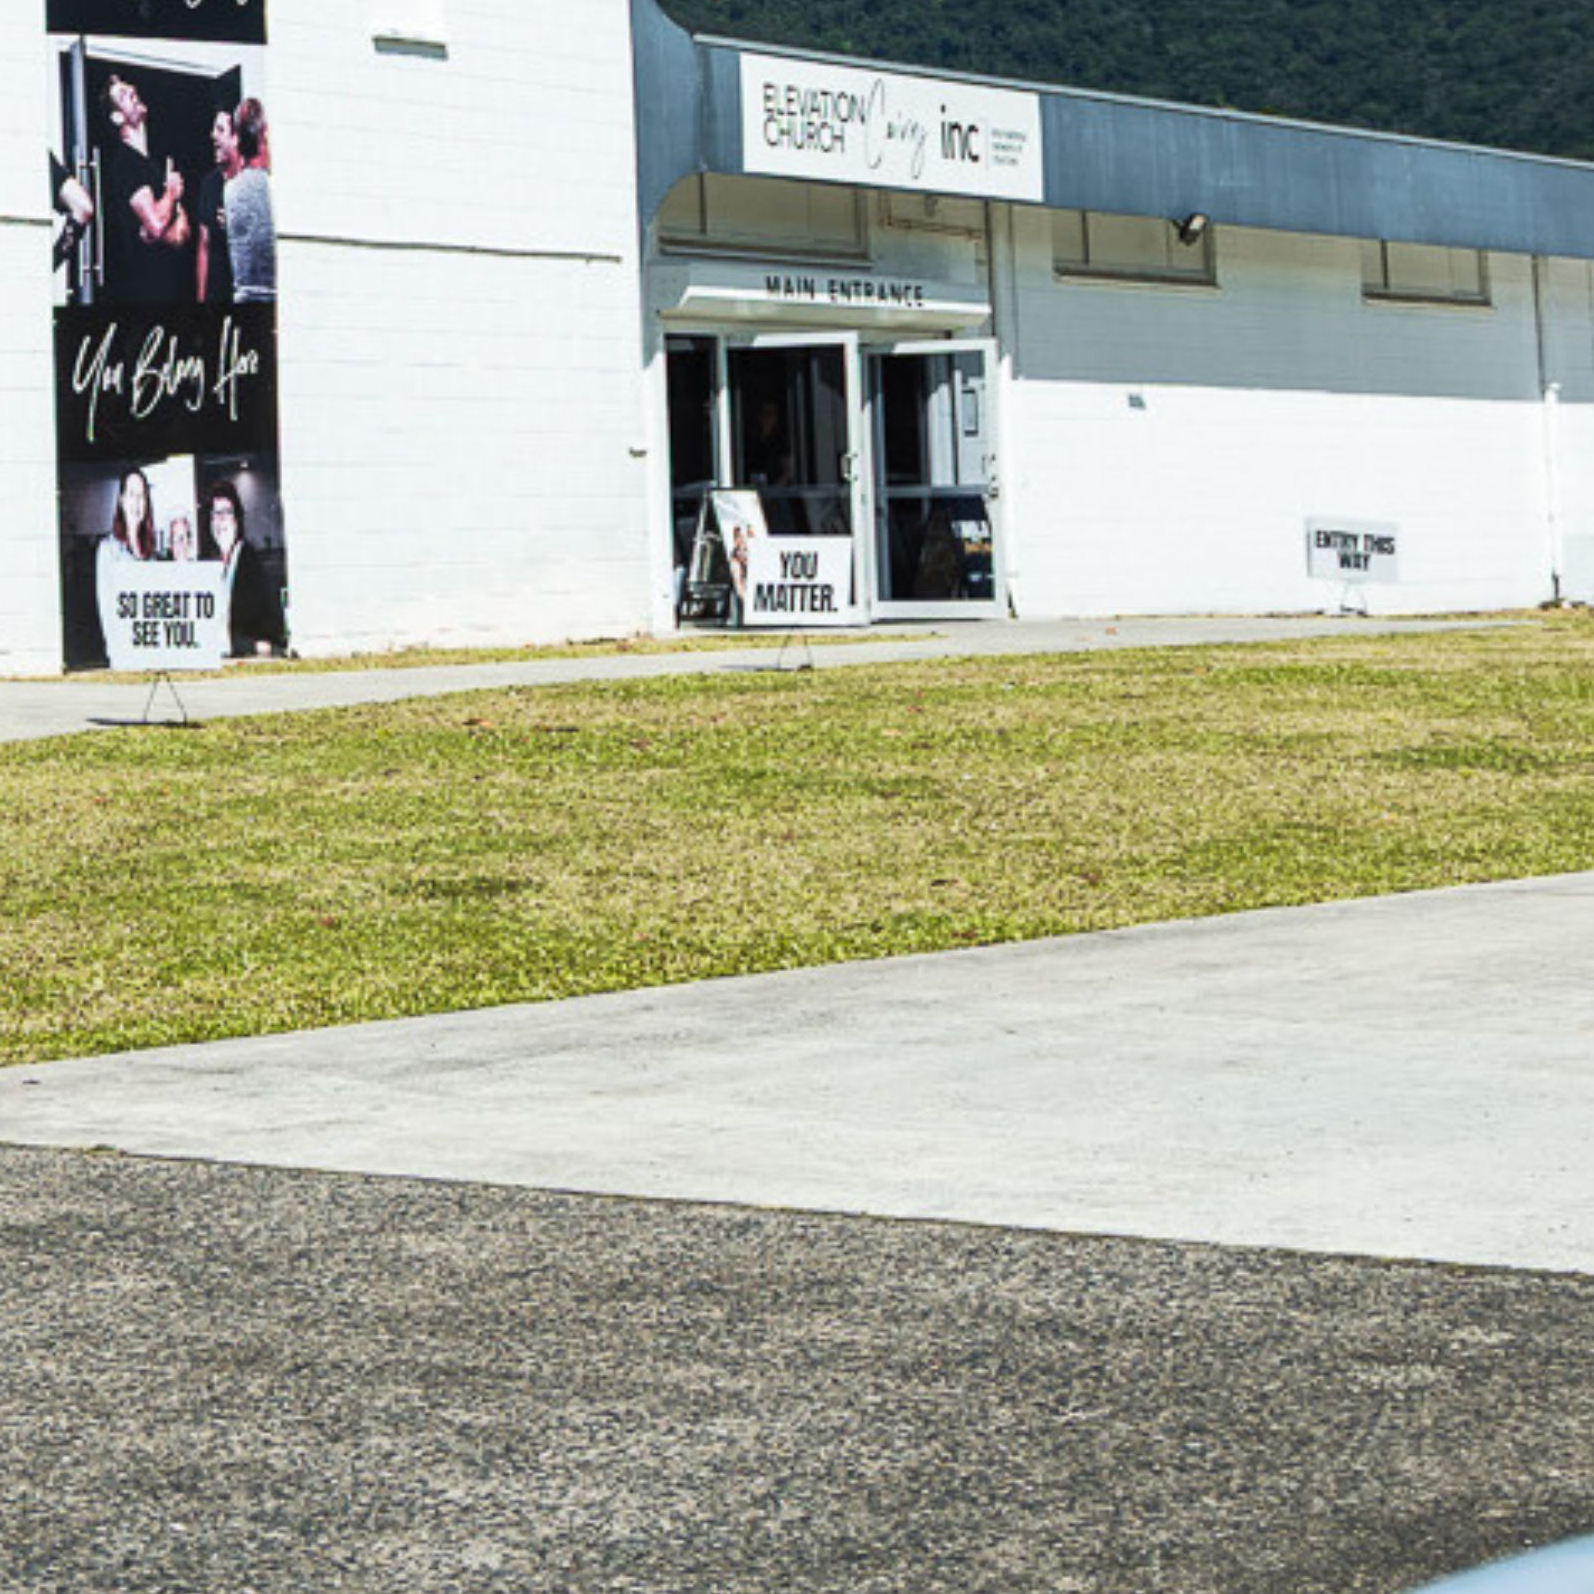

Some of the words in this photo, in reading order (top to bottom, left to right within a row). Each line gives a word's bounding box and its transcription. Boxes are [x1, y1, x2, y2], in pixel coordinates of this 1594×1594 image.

[761, 81, 867, 126] ELEVATION
[761, 115, 847, 154] CHURCH
[939, 103, 981, 164] inc
[765, 275, 816, 300] MAIN
[827, 278, 924, 308] ENTRANCE
[1315, 530, 1359, 551] ENTRY
[1363, 534, 1395, 555] THIS
[780, 549, 819, 581] YOU
[1337, 551, 1370, 571] WAY
[117, 590, 138, 619] SO
[142, 590, 191, 619] GREAT
[193, 590, 215, 619] TO
[752, 582, 839, 613] MATTER.
[132, 620, 161, 648] SEE
[163, 620, 202, 649] YOU.
